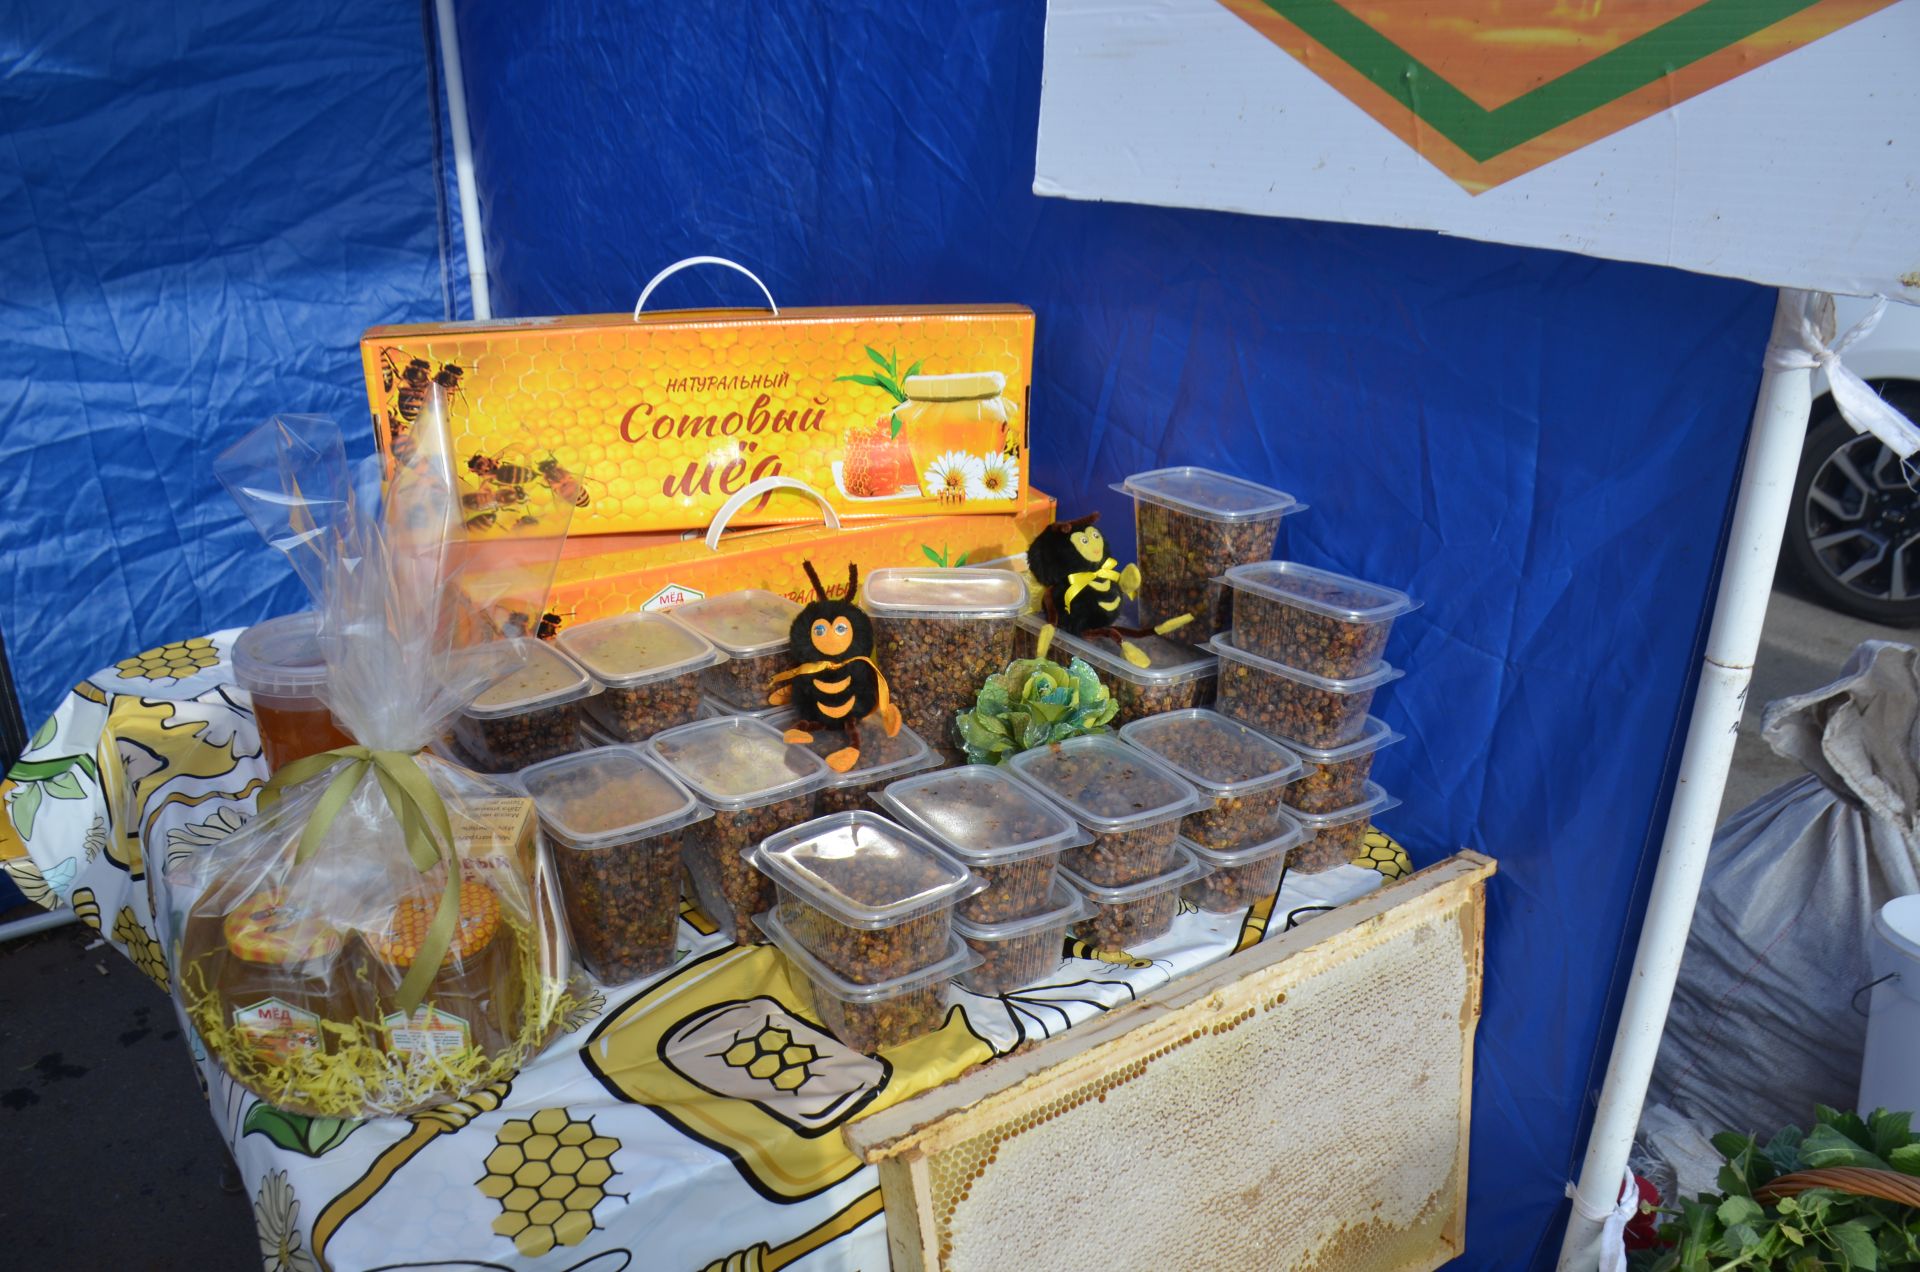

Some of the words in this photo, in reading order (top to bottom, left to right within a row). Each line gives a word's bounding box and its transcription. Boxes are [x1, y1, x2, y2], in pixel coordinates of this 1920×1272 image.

[666, 372, 790, 393] НАТУРАЛЬНЫЙ
[619, 393, 830, 444] Сотовый
[663, 441, 783, 514] мёд
[659, 592, 686, 606] МЁД
[257, 1007, 292, 1026] МЁД
